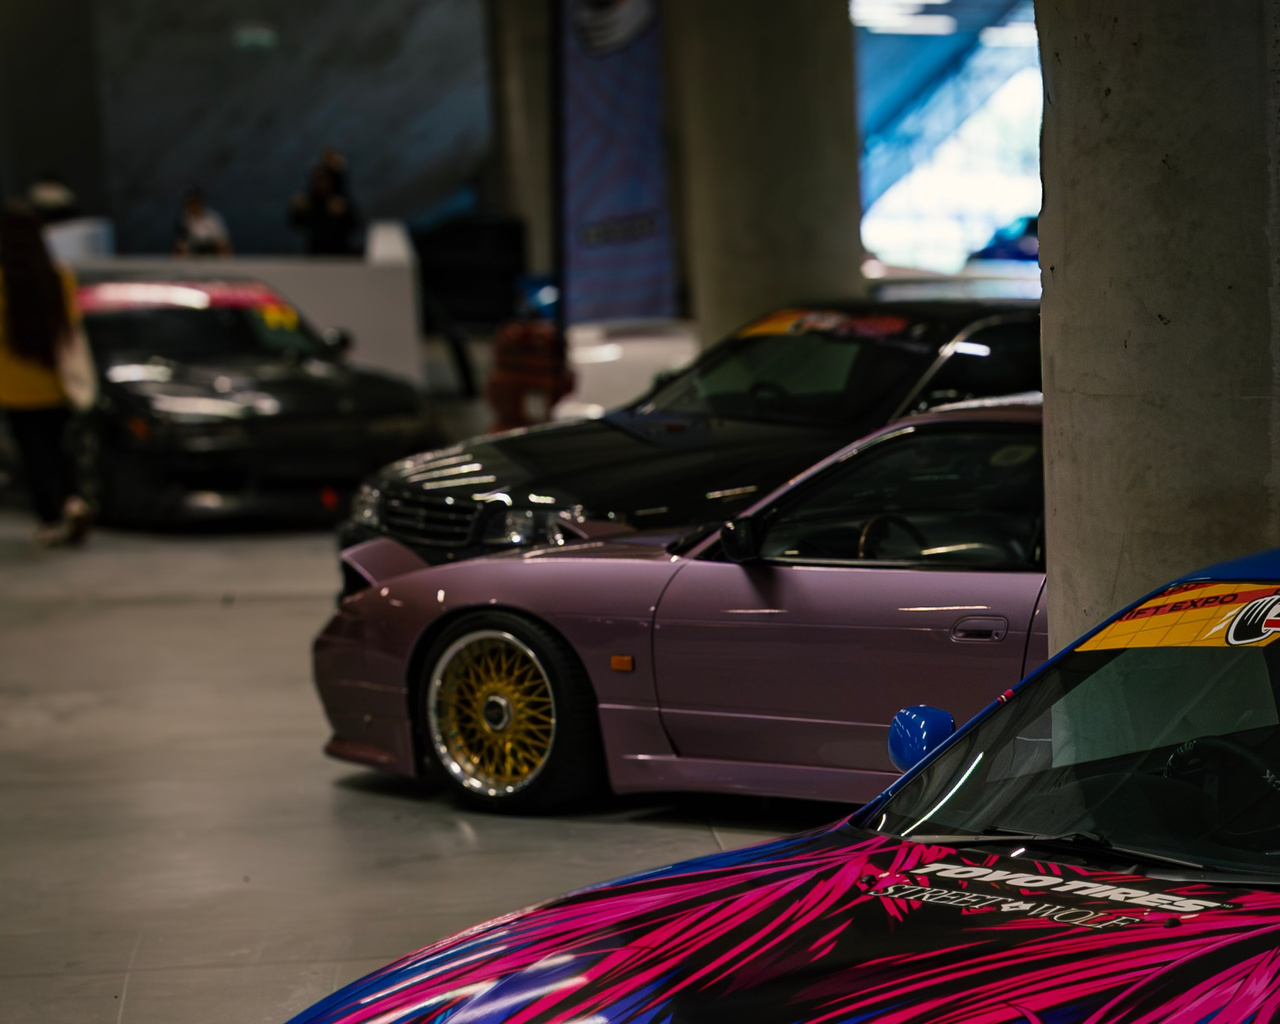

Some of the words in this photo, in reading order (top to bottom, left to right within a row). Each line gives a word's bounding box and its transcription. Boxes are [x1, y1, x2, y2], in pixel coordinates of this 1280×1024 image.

[1168, 594, 1238, 613] EXPO
[870, 884, 1015, 910] STREET
[1026, 903, 1142, 929] WOLF
[910, 863, 1064, 888] TOYO
[1050, 880, 1222, 912] TIRES
